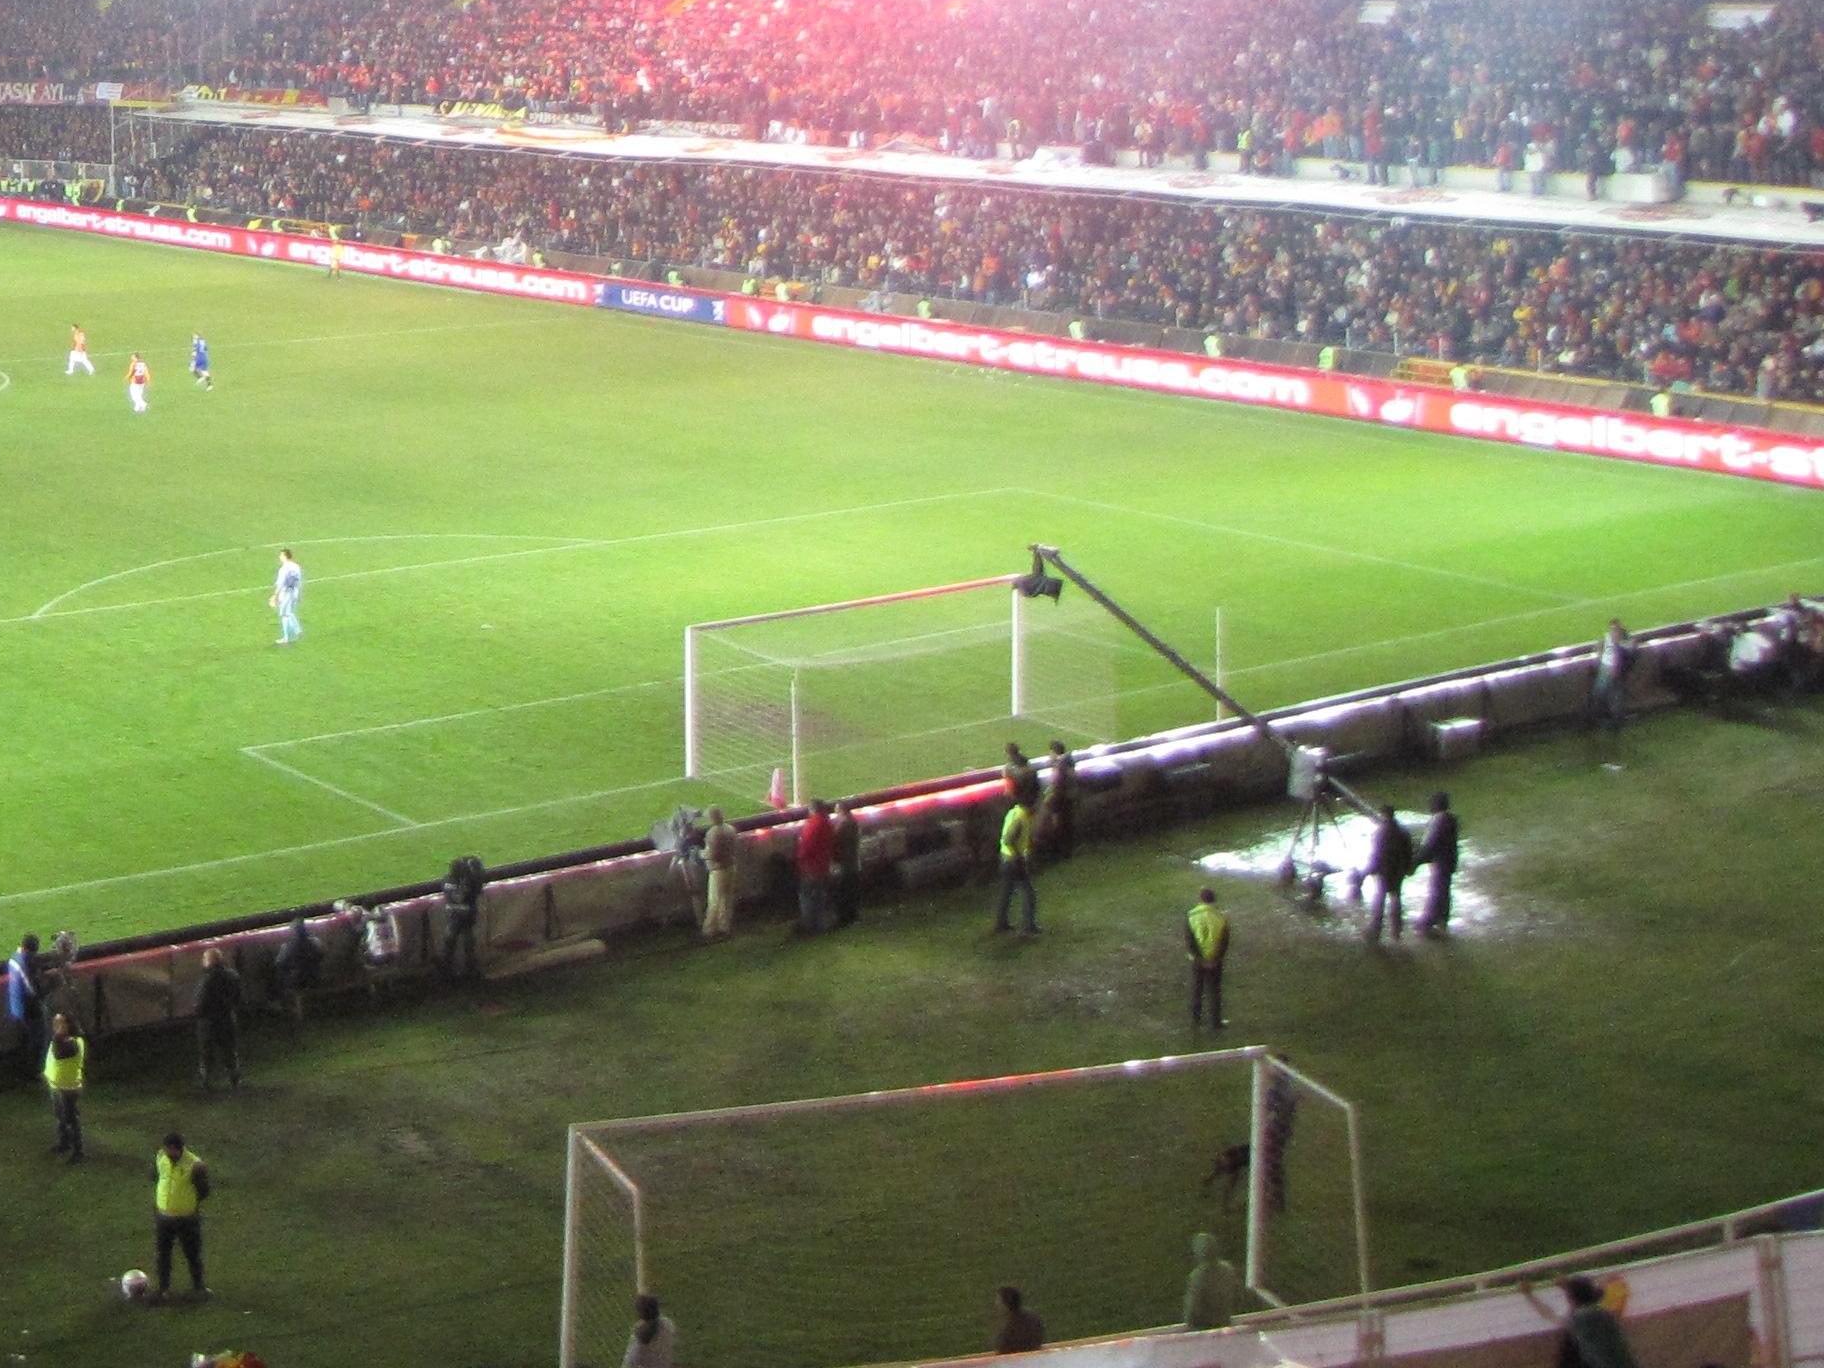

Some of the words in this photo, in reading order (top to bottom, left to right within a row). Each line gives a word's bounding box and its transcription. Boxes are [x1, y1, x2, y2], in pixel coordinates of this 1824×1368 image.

[16, 203, 232, 249] engelbert-strauss.com
[288, 242, 586, 300] engelbert-strauss.com
[621, 289, 658, 308] UEFA
[659, 295, 695, 314] CUP
[811, 314, 1310, 404] engelbert-strauss.com
